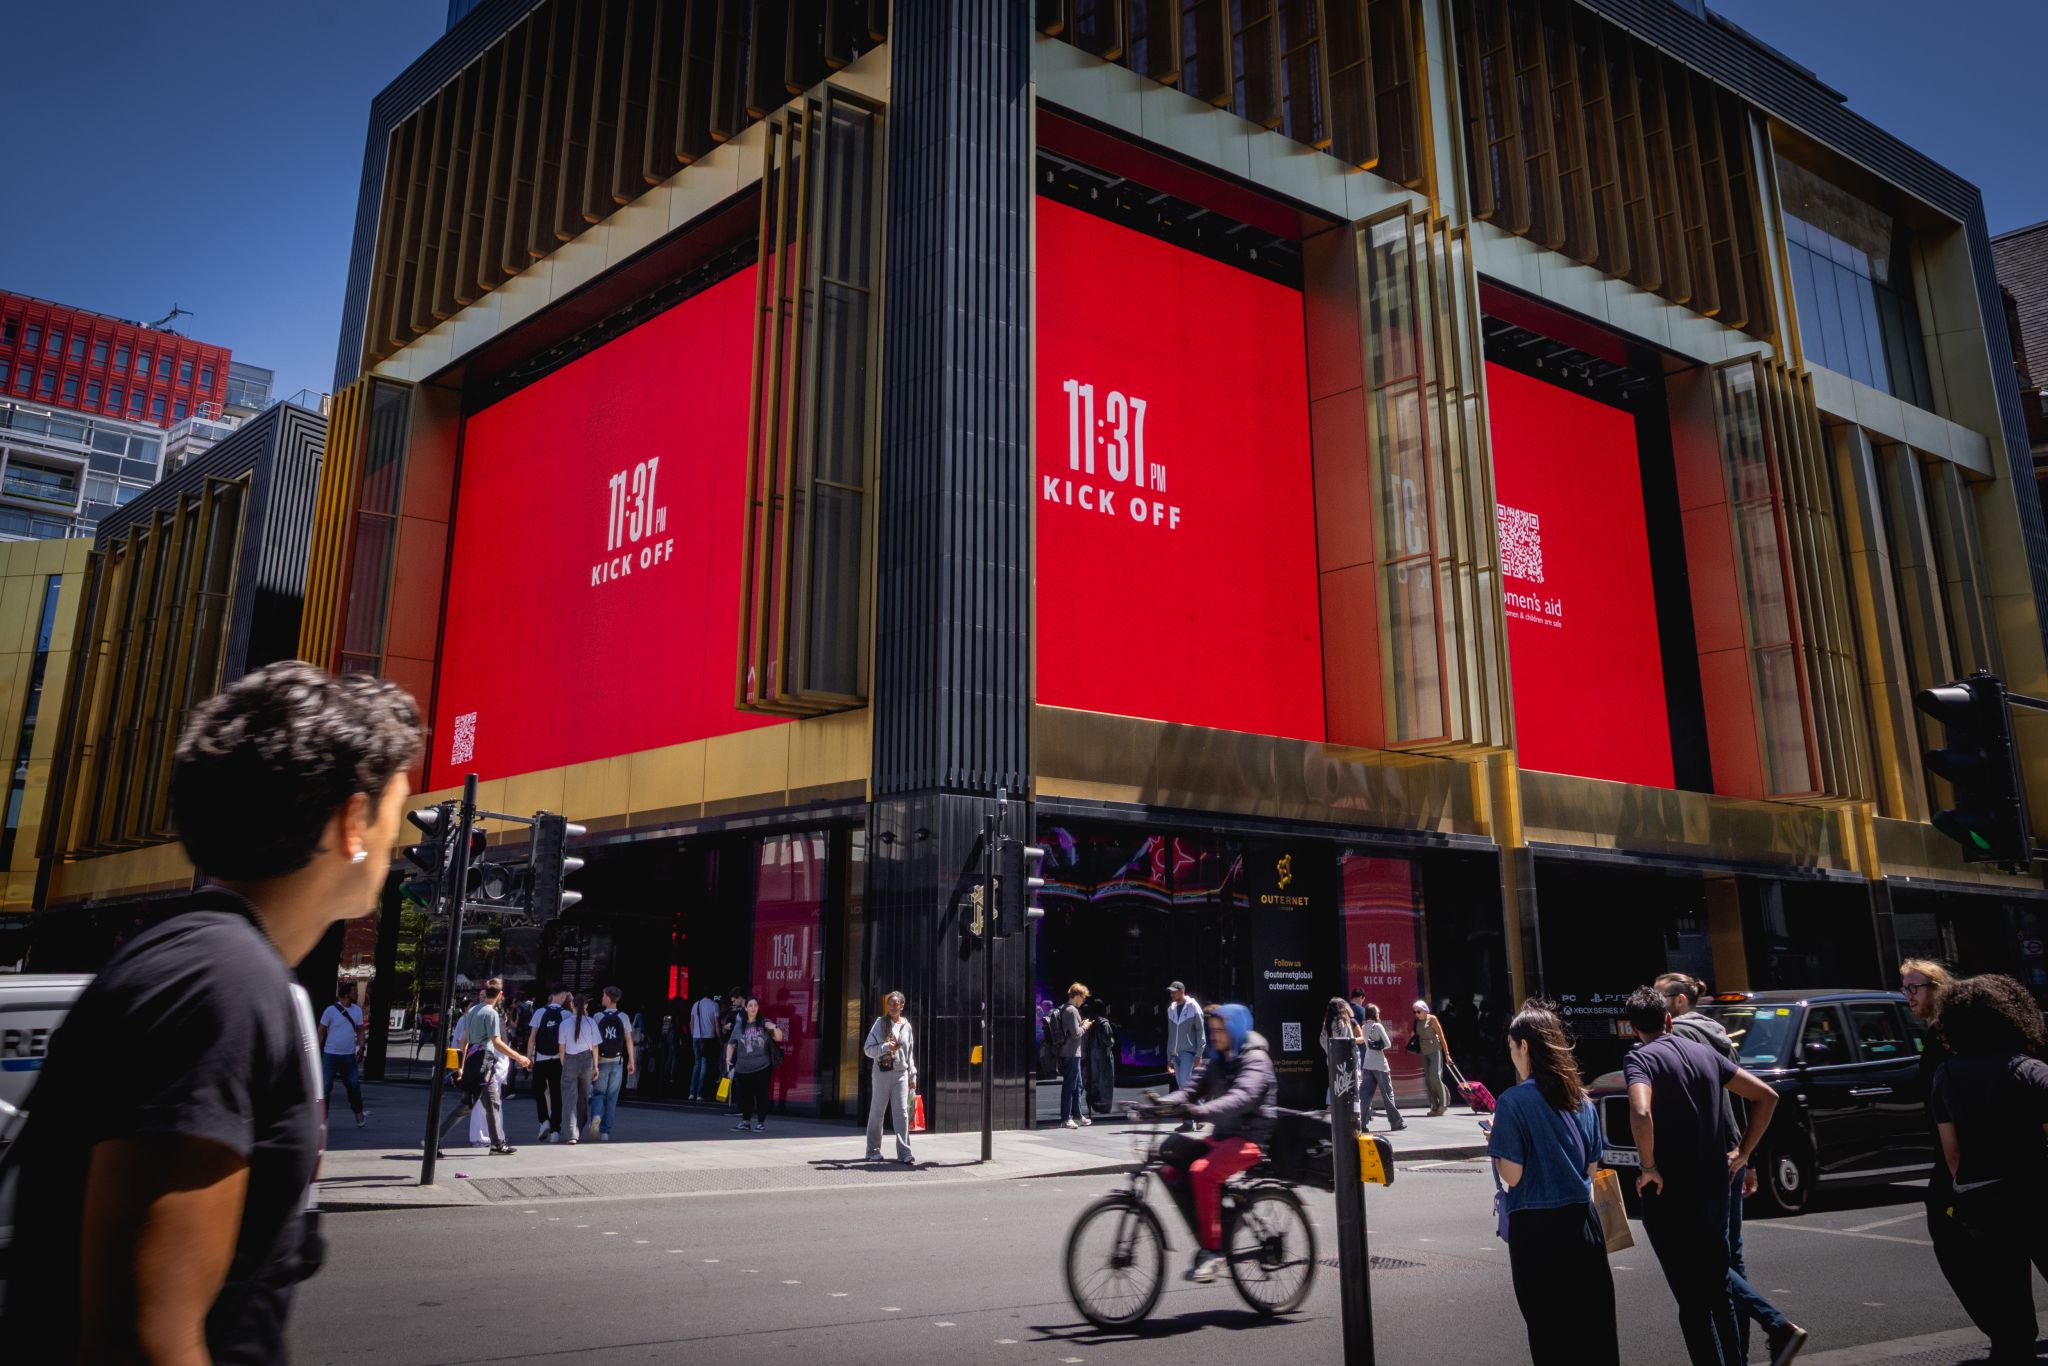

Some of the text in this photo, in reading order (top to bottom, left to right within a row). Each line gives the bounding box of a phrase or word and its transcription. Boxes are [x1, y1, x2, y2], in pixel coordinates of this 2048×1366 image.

[1063, 379, 1166, 493] 11:37 PM
[607, 456, 667, 551] 11:37 PM
[1043, 475, 1181, 530] KICK OFF
[590, 538, 674, 587] KICK OFF
[1544, 597, 1562, 617] aid
[1525, 613, 1543, 624] children
[1261, 894, 1309, 906] OUTERNET
[773, 933, 795, 967] 11:37
[1367, 942, 1391, 973] 11:37
[1274, 959, 1293, 967] Follow
[767, 970, 803, 979] KICK OFF
[1263, 971, 1313, 980] @outernetglobal
[1364, 975, 1402, 985] KICK OFF
